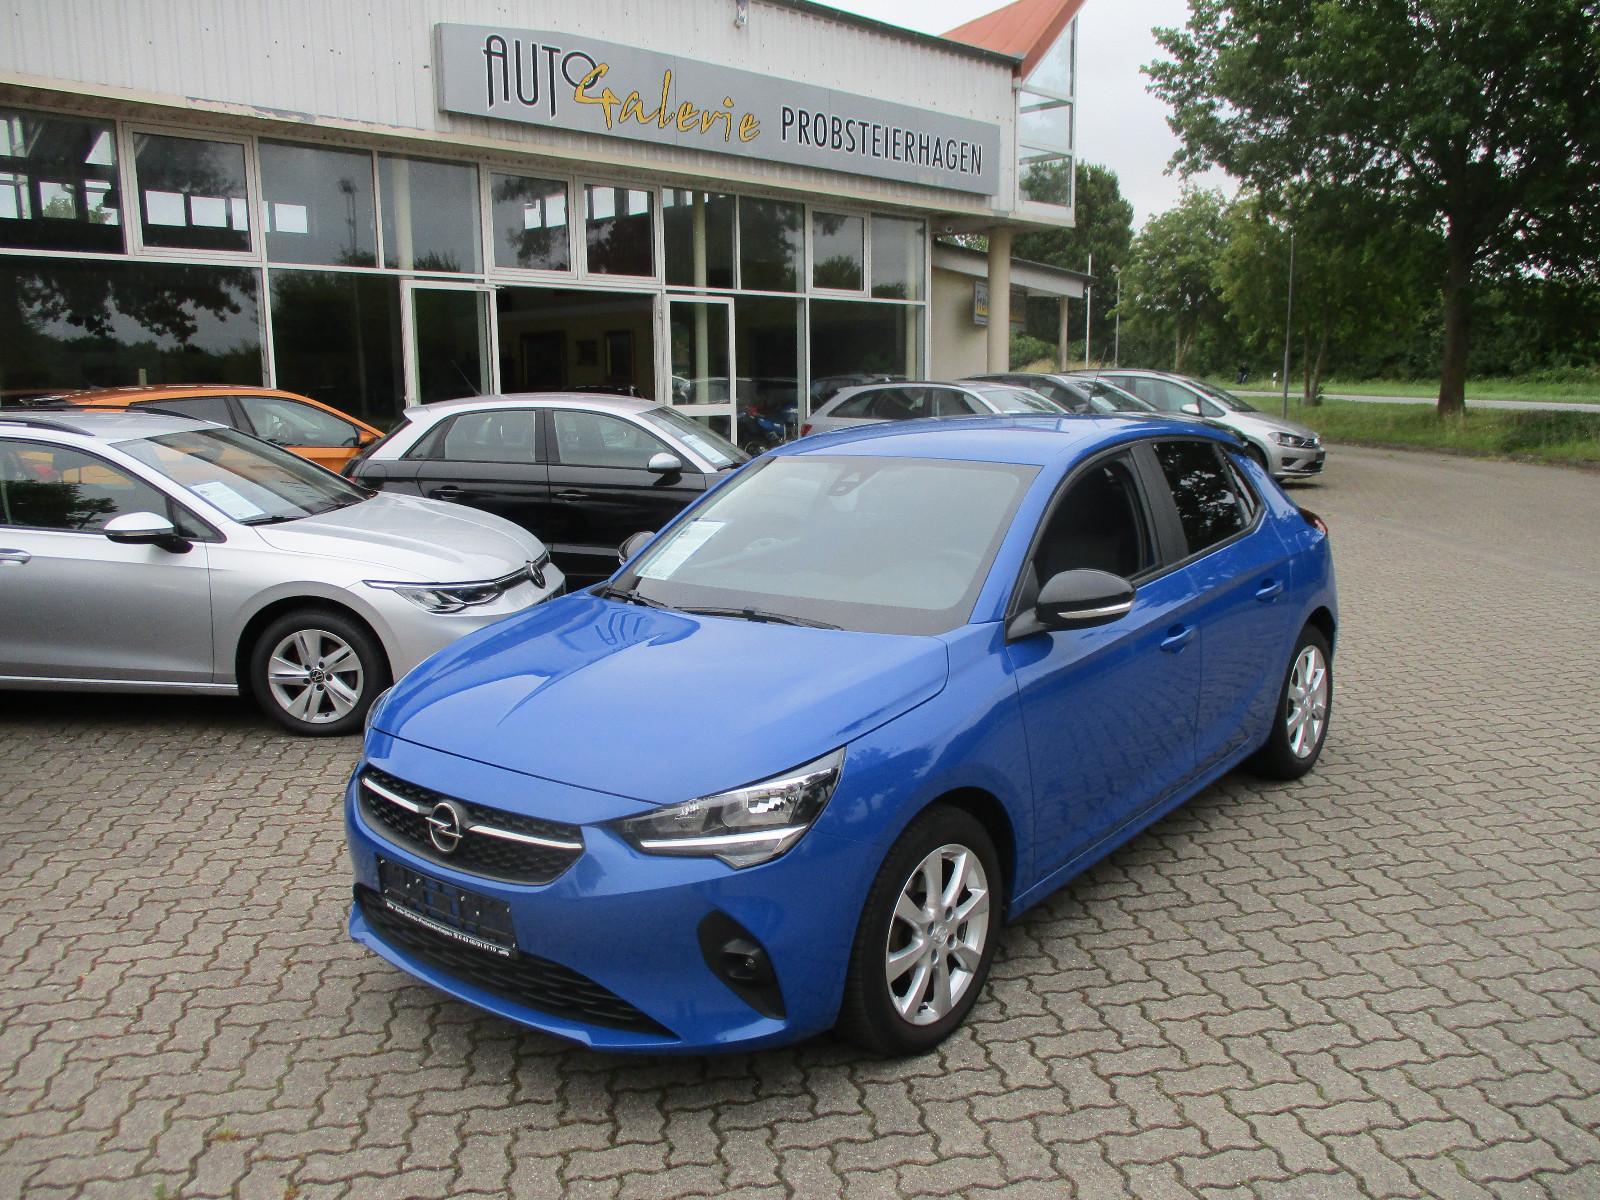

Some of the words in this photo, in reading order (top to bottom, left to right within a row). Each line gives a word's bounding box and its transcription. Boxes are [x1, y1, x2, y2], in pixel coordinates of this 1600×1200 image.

[482, 34, 600, 120] AUTO
[574, 63, 760, 142] Galerie
[781, 105, 983, 176] PROBSTEIERHAGEN
